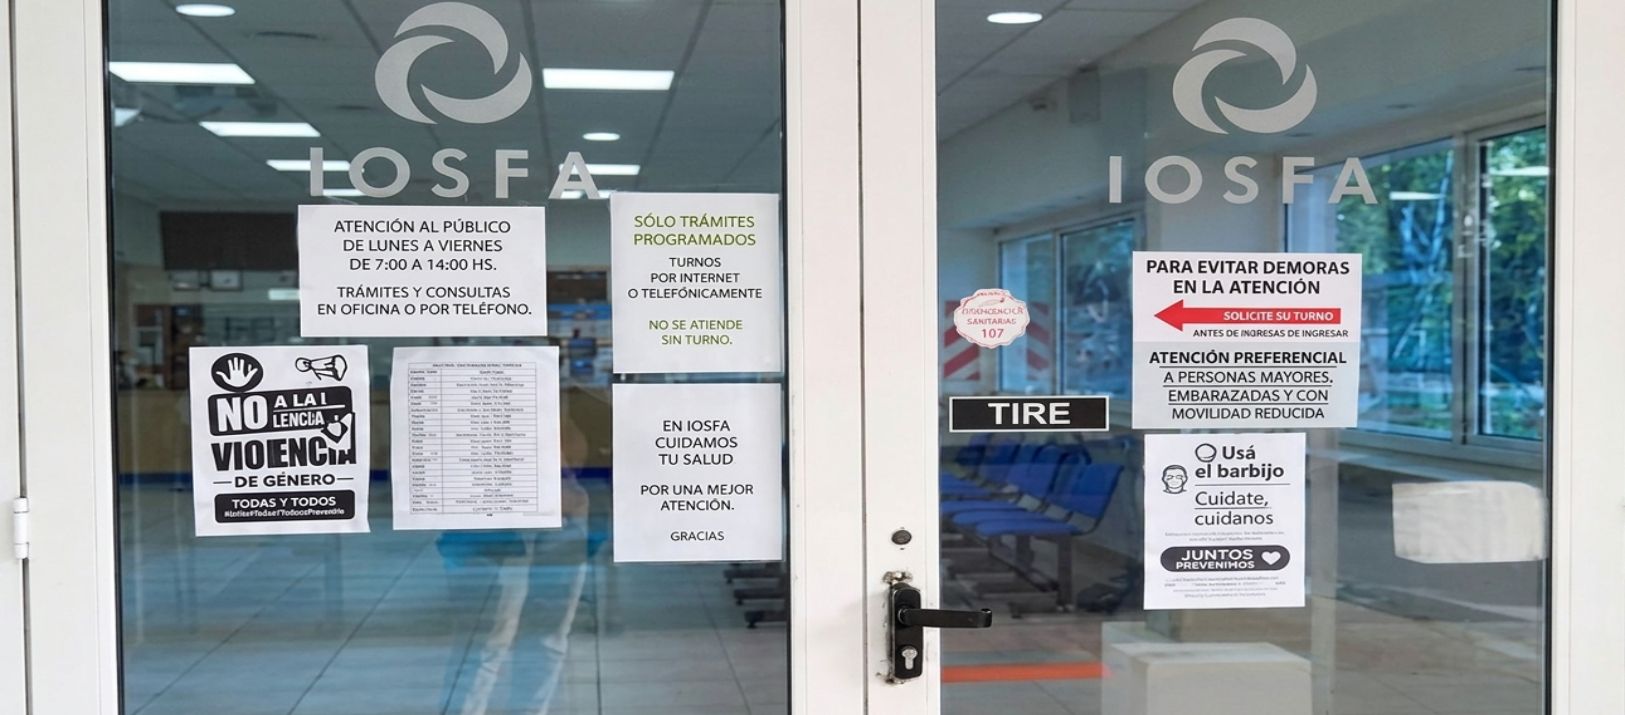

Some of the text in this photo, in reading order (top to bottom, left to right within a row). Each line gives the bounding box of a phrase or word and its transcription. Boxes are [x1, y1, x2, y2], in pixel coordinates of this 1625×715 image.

[309, 147, 603, 199] IOSFA
[1109, 155, 1378, 204] IOSFA
[333, 217, 511, 234] ATENCIÓN AL PÚBLICO
[633, 212, 755, 229] SÓLO TRÁMITES
[343, 239, 503, 252] DE LUNES A VIERNES
[633, 233, 757, 247] PROGRAMADOS
[349, 258, 497, 271] DE 7:00 A 14:00 HS.
[668, 257, 722, 268] TURNOS
[1146, 259, 1350, 275] PARA EVITAR DEMORAS
[650, 272, 741, 284] POR INTERNET
[336, 283, 511, 299] TRÁMITES Y CONSULTAS
[627, 286, 763, 299] O TELEFÓNICAMENTE
[1173, 277, 1320, 295] EN LA ATENCIÓN
[317, 301, 532, 316] EN OFICINA O POR TELÉFONO.
[1223, 311, 1334, 322] SOLICITE SU TURNO
[648, 319, 743, 331] NO SE ATIENDE
[661, 334, 733, 346] SIN TURNO.
[981, 327, 1005, 339] 107
[1192, 329, 1225, 338] ANTES
[1225, 329, 1240, 338] DE
[1287, 329, 1300, 338] DE
[1301, 329, 1349, 338] INGRESAR
[1148, 349, 1347, 364] ATENCIÓN PREFERENCIAL
[1163, 371, 1175, 384] A
[1178, 370, 1257, 384] PERSONAS
[1168, 389, 1329, 402] EMBARAZADAS Y CON
[216, 394, 268, 432] NO
[274, 394, 288, 408] A
[293, 393, 317, 407] LA
[987, 402, 1071, 425] TIRE
[1171, 407, 1325, 420] MOVILIDAD REDUCIDA
[662, 419, 731, 433] EN IOSFA
[654, 436, 739, 449] CUIDAMOS
[658, 453, 734, 466] TU SALUD
[1222, 444, 1256, 461] Usá
[1194, 462, 1285, 482] el barbijo
[234, 471, 336, 488] DE GÉNERO
[640, 483, 754, 496] POR UNA MEJOR
[231, 496, 337, 509] TODAS Y TODOS
[660, 497, 735, 512] ATENCIÓN.
[1194, 490, 1269, 507] Cuidate,
[1194, 510, 1274, 526] cuidanos
[670, 530, 725, 542] GRACIAS
[1180, 548, 1254, 561] JUNTOS
